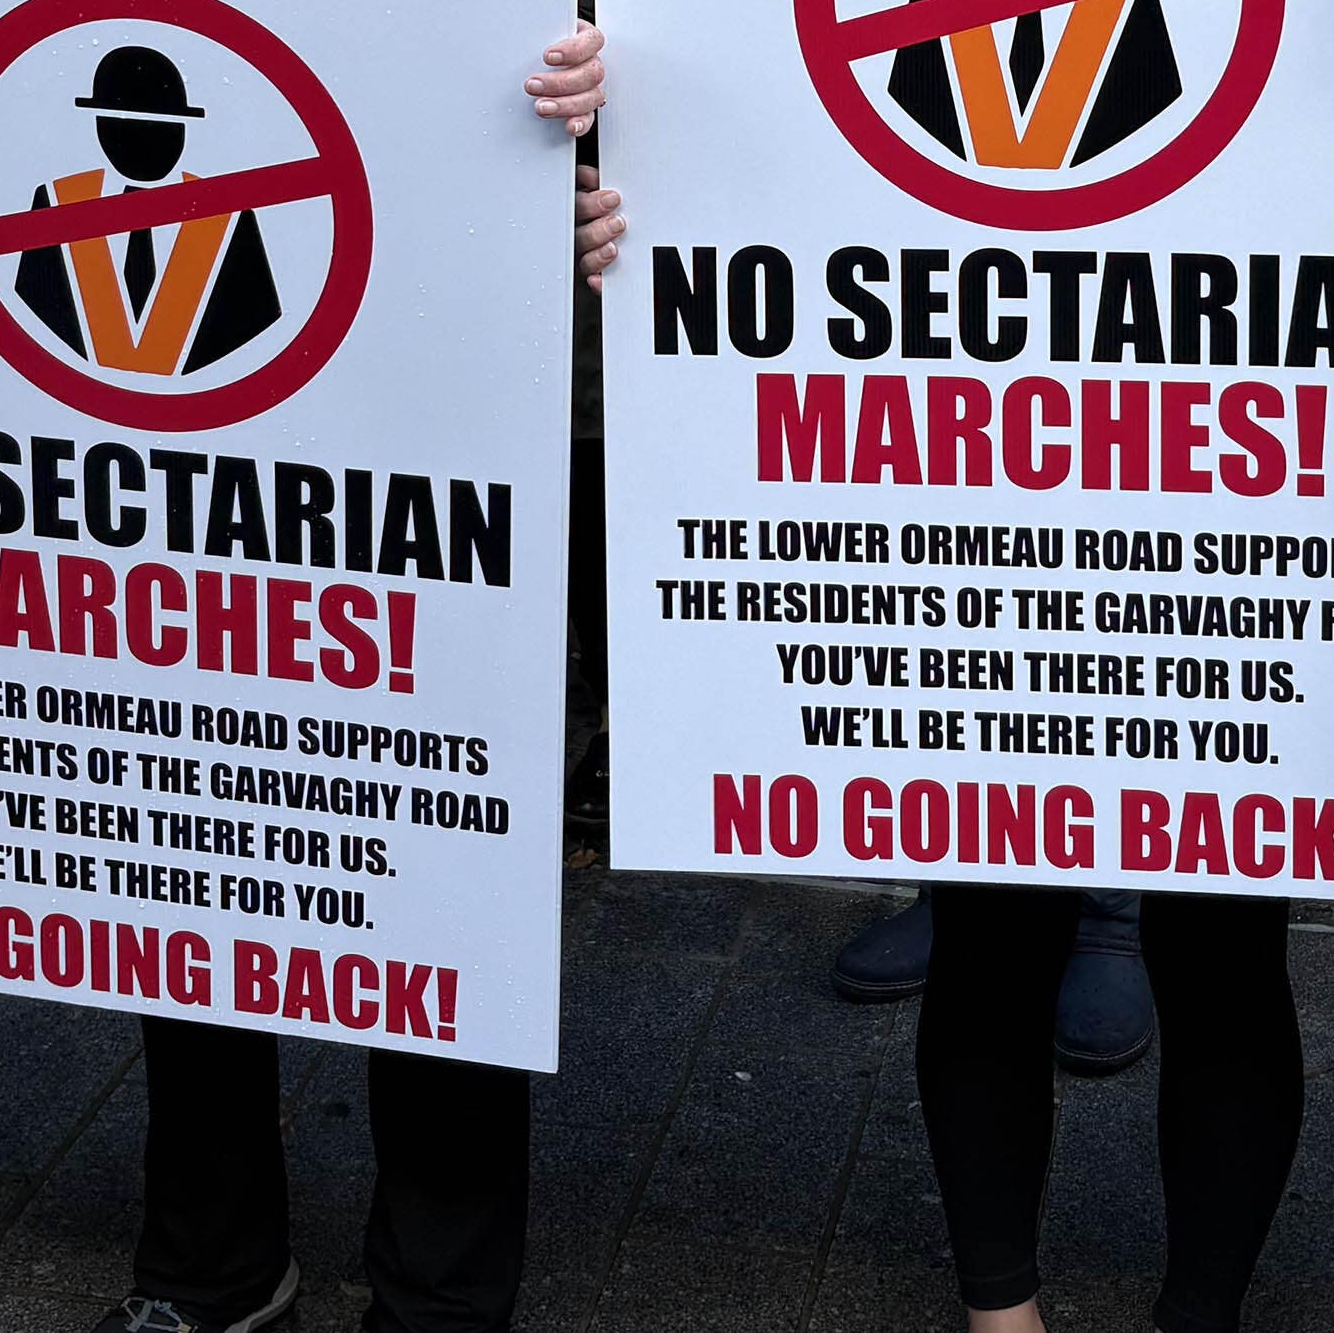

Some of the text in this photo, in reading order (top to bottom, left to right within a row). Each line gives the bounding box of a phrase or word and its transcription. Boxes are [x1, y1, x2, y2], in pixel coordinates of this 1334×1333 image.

[653, 245, 793, 358] NO
[757, 373, 1327, 497] MARCHES!
[678, 520, 748, 559] THE
[759, 521, 889, 563] LOWER
[901, 524, 1063, 568] ORMEAU
[1076, 529, 1182, 572] ROAD
[656, 580, 726, 620] THE
[737, 582, 945, 627] RESIDENTS
[957, 587, 1003, 628] OF
[1012, 590, 1084, 631] THE
[1096, 592, 1310, 640] GARVAGHY
[920, 649, 1013, 690] BEEN
[1024, 652, 1144, 696] THERE
[1156, 657, 1229, 699] FOR
[1242, 661, 1304, 702] US.
[37, 686, 181, 738] ORMEAU
[192, 704, 287, 750] ROAD
[298, 717, 488, 775] SUPPORTS
[919, 710, 965, 750] BE
[975, 712, 1094, 756] THERE
[1106, 717, 1178, 759] FOR
[1189, 721, 1278, 764] YOU.
[88, 748, 128, 786] OF
[137, 753, 201, 796] THE
[211, 763, 402, 820] GARVAGHY
[412, 787, 508, 834] ROAD
[714, 774, 818, 858] NO
[843, 777, 1094, 869] GOING
[56, 798, 138, 843] BEEN
[148, 810, 255, 858] THERE
[265, 825, 329, 868] FOR
[341, 835, 396, 877] US.
[56, 853, 96, 892] BE
[105, 859, 211, 907] THERE
[221, 874, 284, 917] FOR
[294, 884, 373, 929] YOU.
[234, 939, 458, 1042] BACK!
